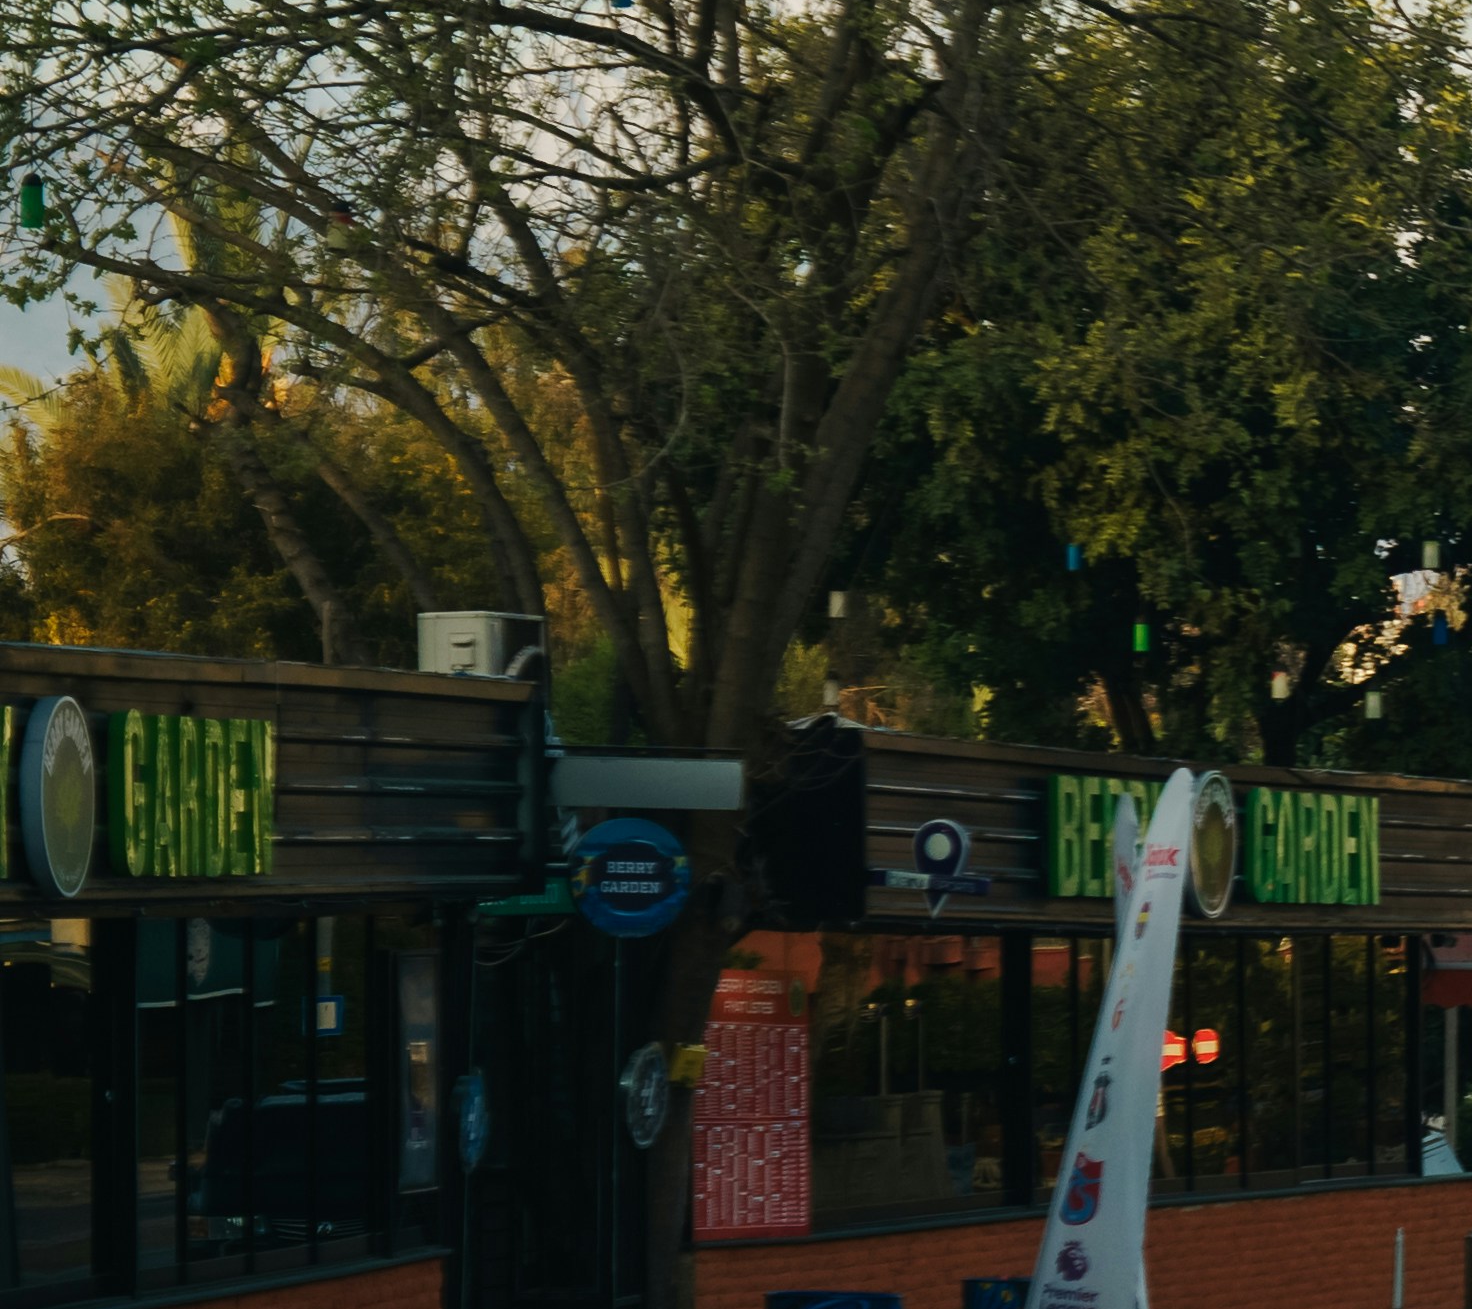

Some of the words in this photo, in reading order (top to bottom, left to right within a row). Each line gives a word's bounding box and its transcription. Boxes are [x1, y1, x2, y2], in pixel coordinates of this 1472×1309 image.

[120, 707, 276, 879] GARDEN
[606, 861, 658, 874] BERRY
[1246, 786, 1381, 905] GARDEN
[600, 881, 661, 894] GARDEN
